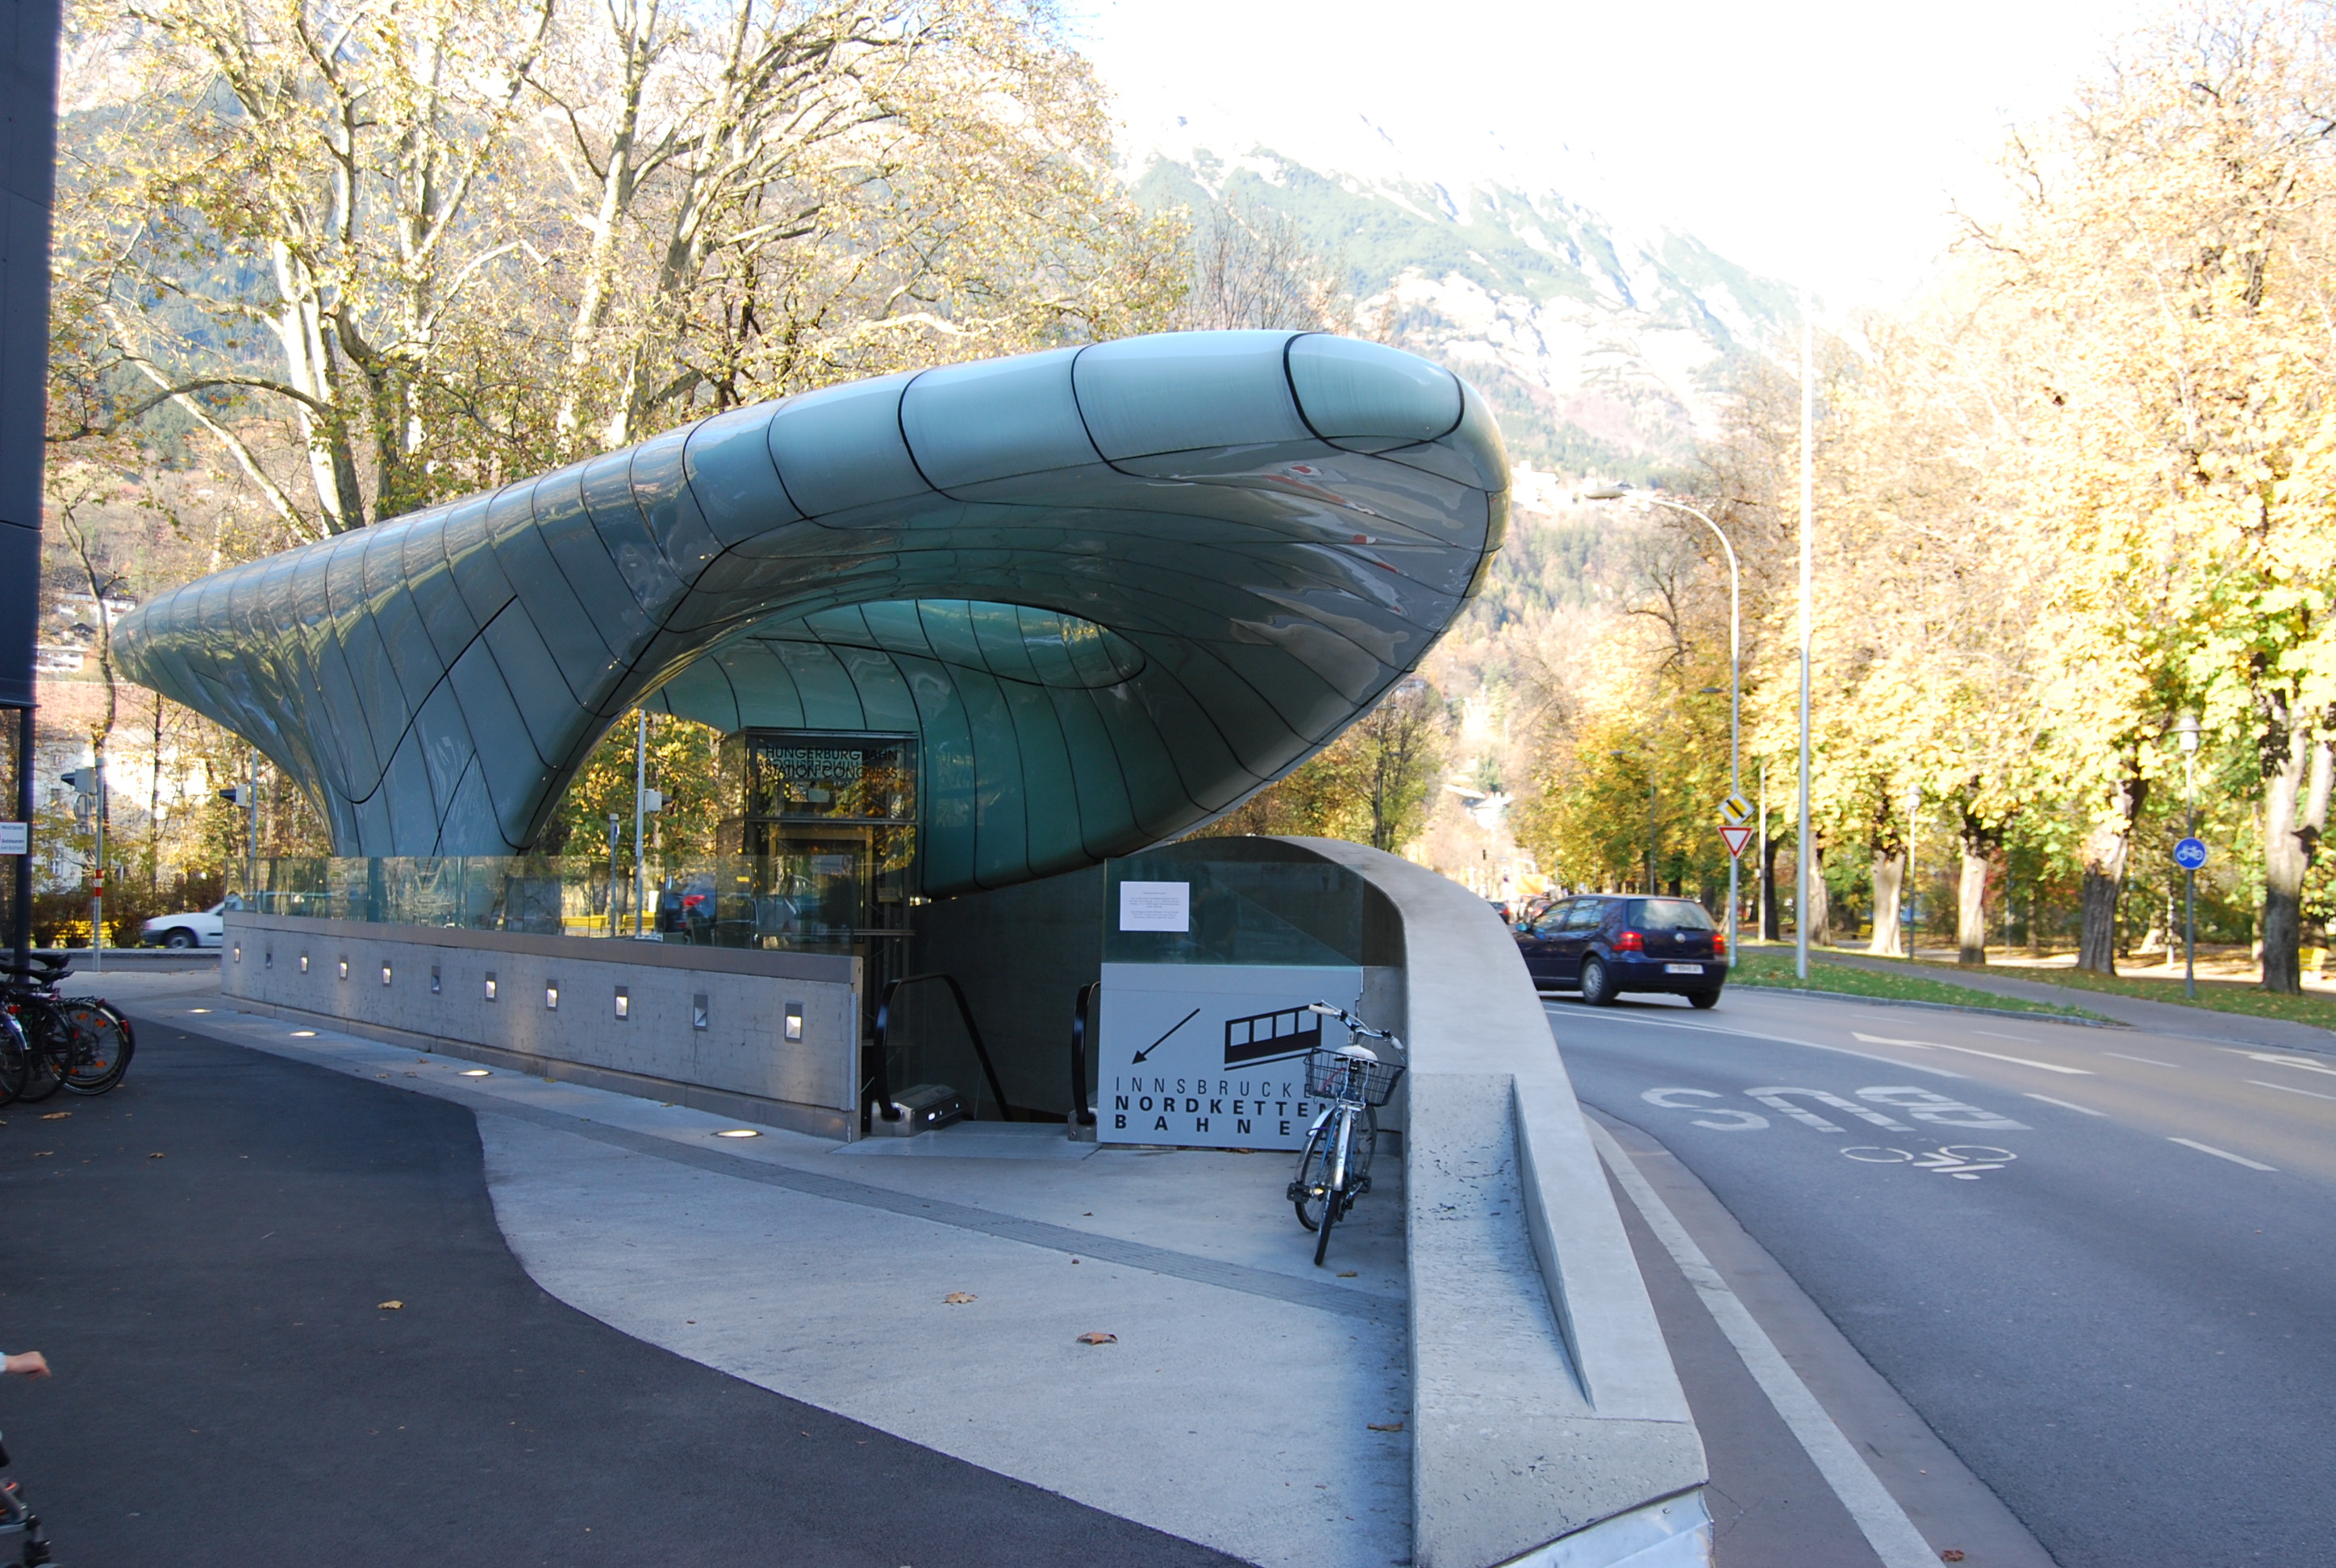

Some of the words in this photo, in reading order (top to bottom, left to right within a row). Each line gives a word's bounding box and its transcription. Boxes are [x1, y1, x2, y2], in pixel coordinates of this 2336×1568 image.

[766, 746, 898, 762] HUNGERBURGBAHN
[767, 765, 818, 778] STATION
[822, 767, 898, 781] CONGRESS
[1641, 1086, 2036, 1132] BUS
[1115, 1114, 1333, 1138] BAHNE
